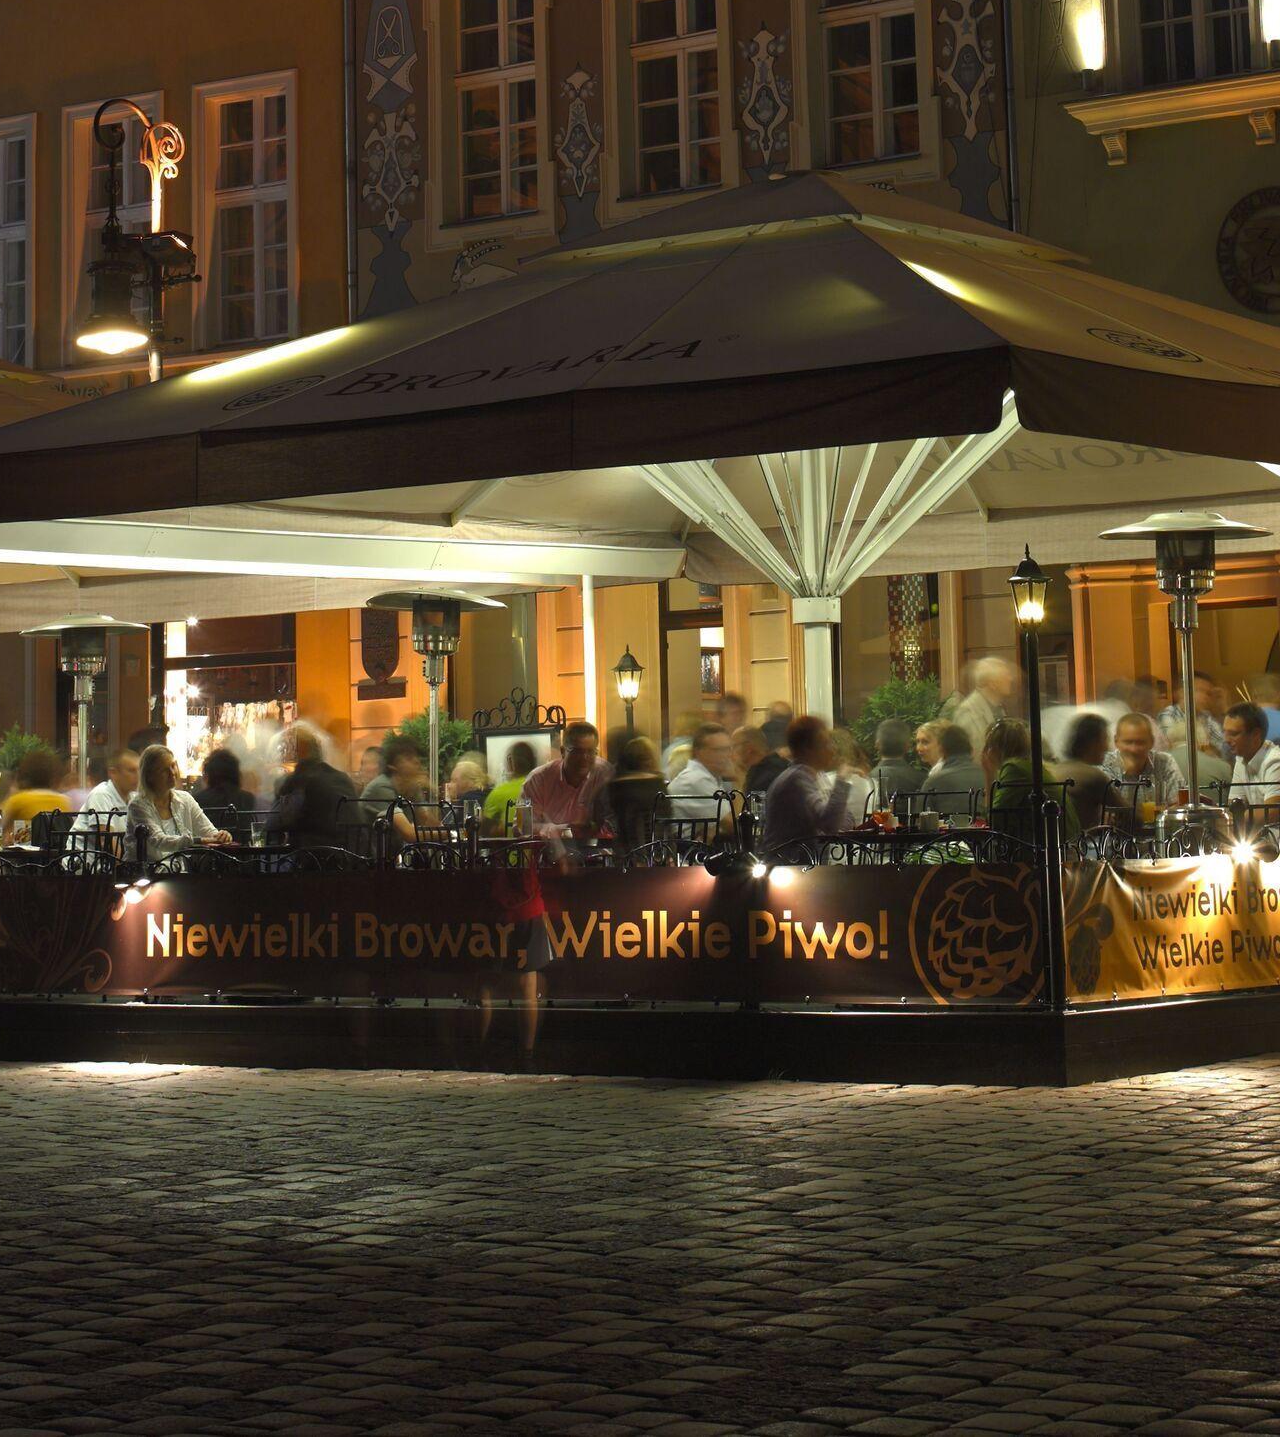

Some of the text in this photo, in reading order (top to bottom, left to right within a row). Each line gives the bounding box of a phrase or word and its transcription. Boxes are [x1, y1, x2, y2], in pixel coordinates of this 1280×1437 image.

[326, 339, 703, 396] BROVARIA
[1132, 882, 1239, 922] Niewielki
[145, 909, 889, 969] Niewielki Browar, Wielkie Piwo!
[1133, 932, 1225, 970] Wielkie
